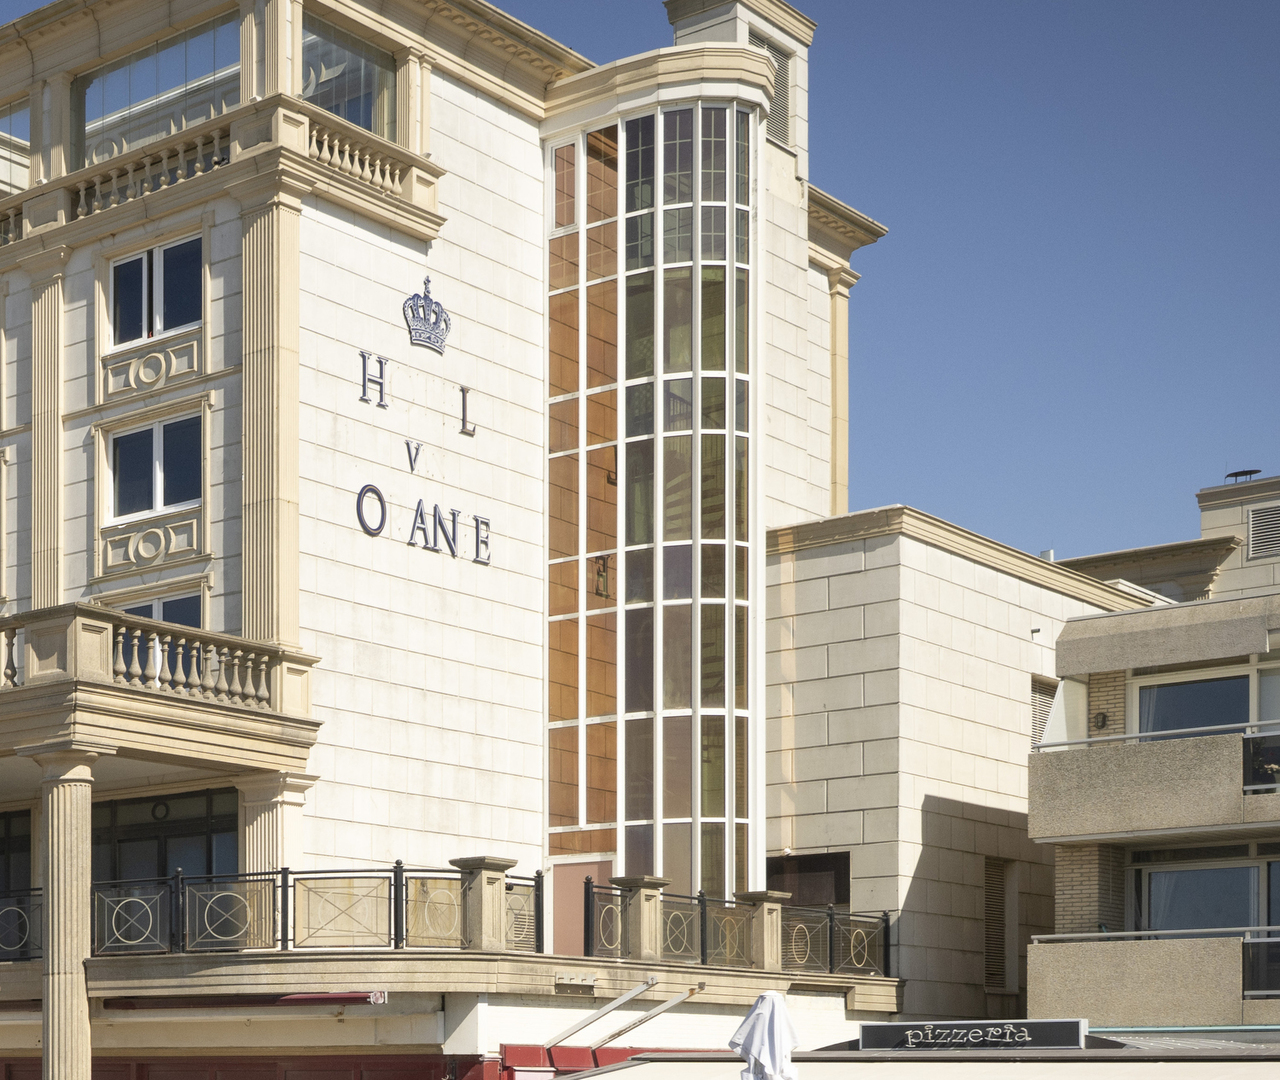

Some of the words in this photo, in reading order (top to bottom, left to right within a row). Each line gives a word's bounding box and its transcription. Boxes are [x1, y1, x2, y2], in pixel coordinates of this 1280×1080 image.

[358, 351, 389, 409] H
[458, 385, 477, 437] L
[356, 484, 387, 537] O
[904, 1024, 1033, 1048] pizzeria
